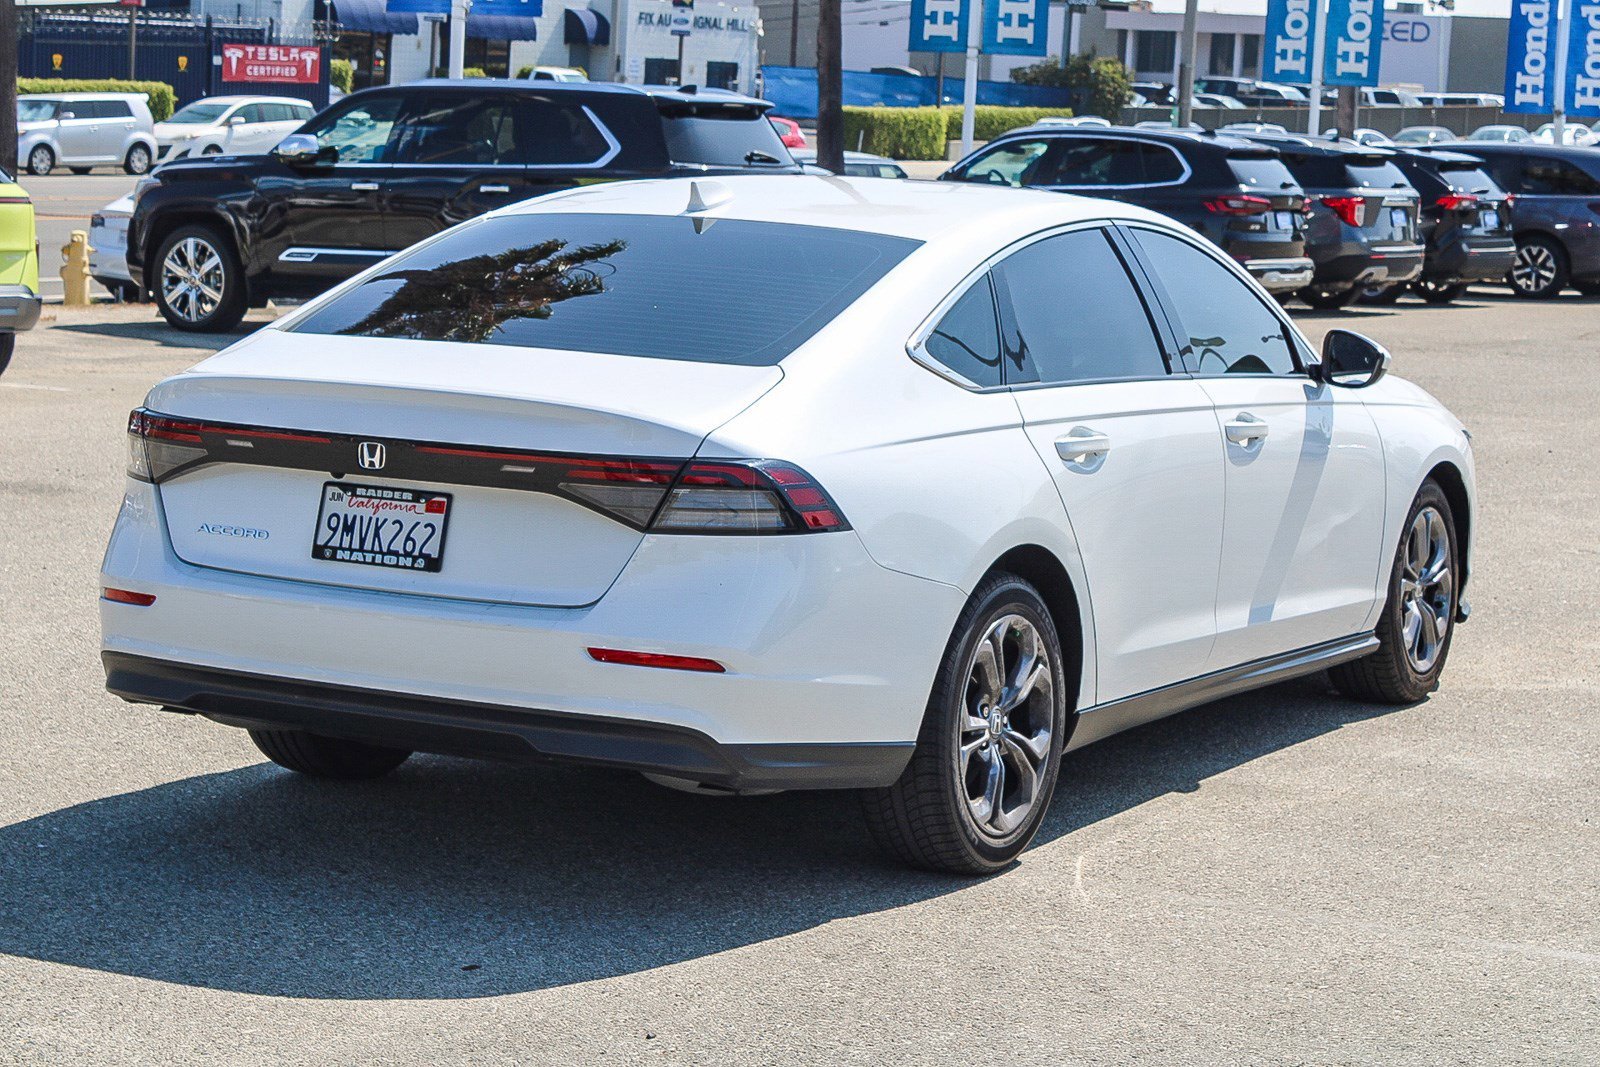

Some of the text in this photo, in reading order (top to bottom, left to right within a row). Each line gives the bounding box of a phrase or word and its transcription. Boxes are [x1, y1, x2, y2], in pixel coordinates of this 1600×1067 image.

[638, 12, 655, 26] FIX
[658, 13, 672, 28] AU
[693, 16, 724, 31] IGNAL
[726, 18, 748, 33] HILL
[245, 45, 300, 62] TESLA
[1515, 0, 1551, 107] Hond
[1574, 0, 1600, 109] Hond
[246, 65, 298, 77] CERTIFIED
[328, 491, 344, 503] JUN
[356, 487, 413, 501] RAIDER
[347, 496, 425, 516] California
[197, 523, 270, 540] ACCORD
[323, 512, 437, 558] 9MVK262
[336, 549, 413, 568] NATION
